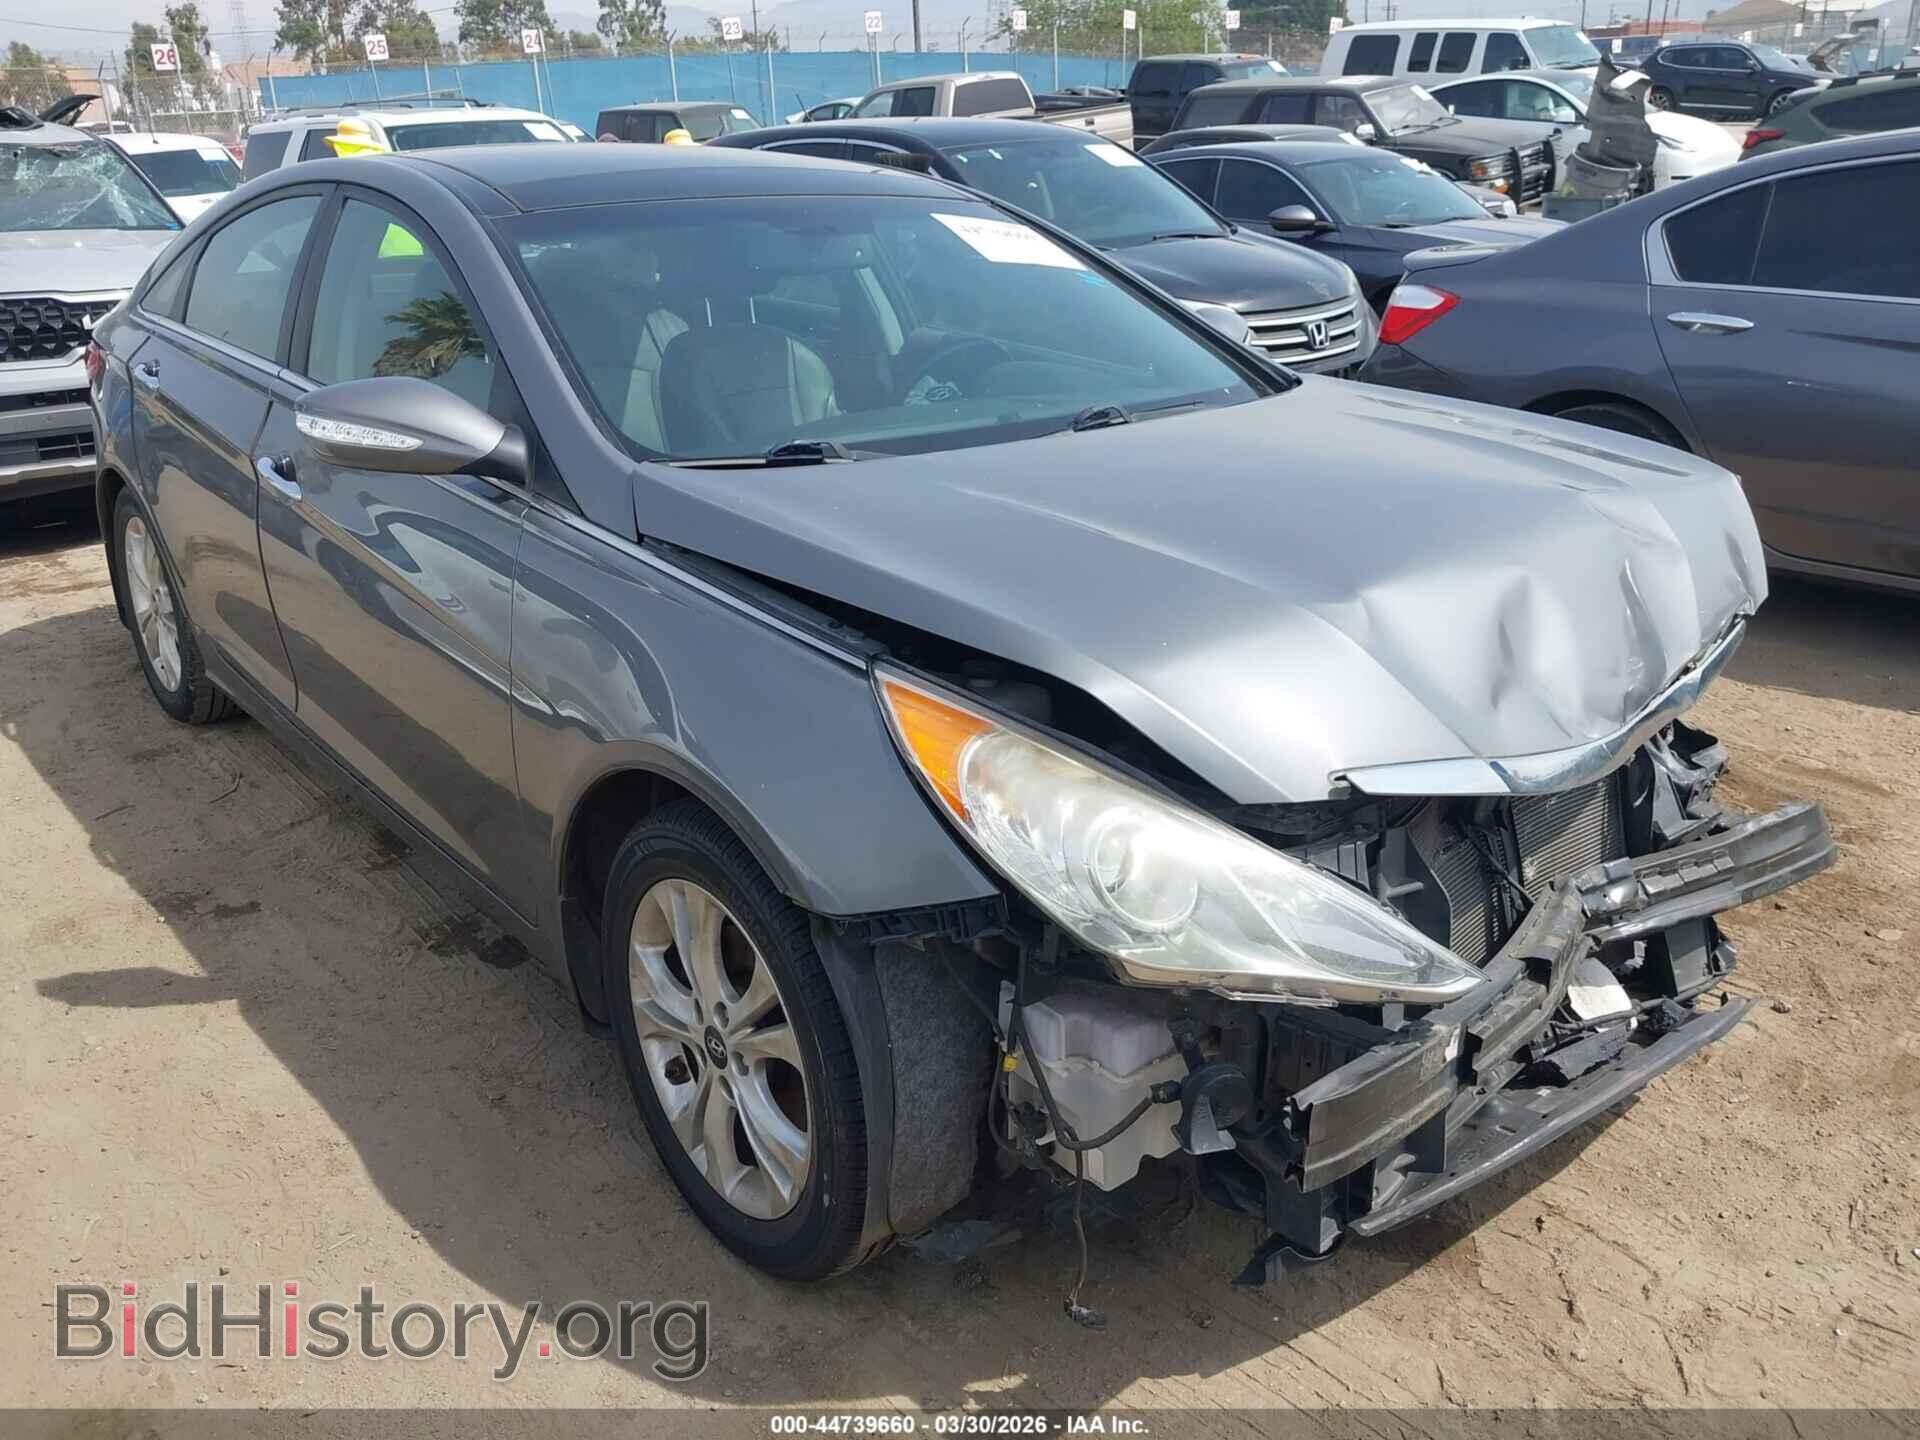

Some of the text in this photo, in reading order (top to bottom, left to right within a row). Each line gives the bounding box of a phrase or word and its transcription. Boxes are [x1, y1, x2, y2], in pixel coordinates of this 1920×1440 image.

[724, 21, 741, 35] 23
[866, 16, 881, 29] 22
[524, 31, 542, 49] 24
[367, 41, 386, 55] 25
[154, 49, 176, 65] 26
